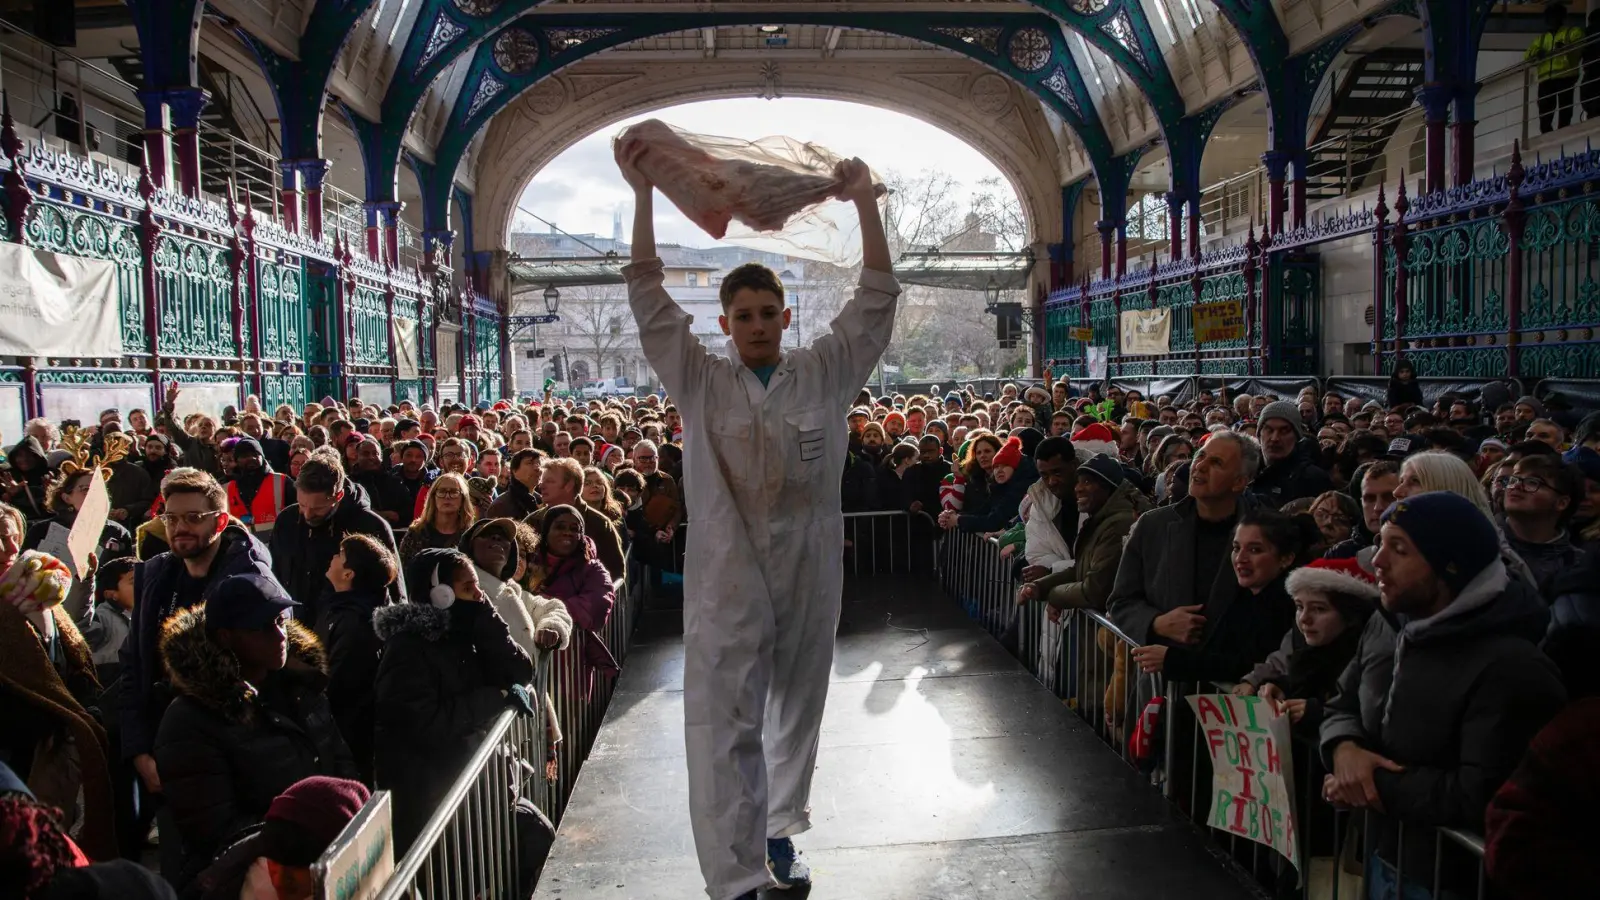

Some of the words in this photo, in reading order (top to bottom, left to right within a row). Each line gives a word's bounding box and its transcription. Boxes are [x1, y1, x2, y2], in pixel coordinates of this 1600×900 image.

[1195, 304, 1236, 319] THIS
[1237, 695, 1267, 733] I
[1208, 729, 1251, 767] FOR
[1255, 737, 1280, 774] CH
[1236, 766, 1270, 804] IS
[1285, 814, 1294, 857] B
